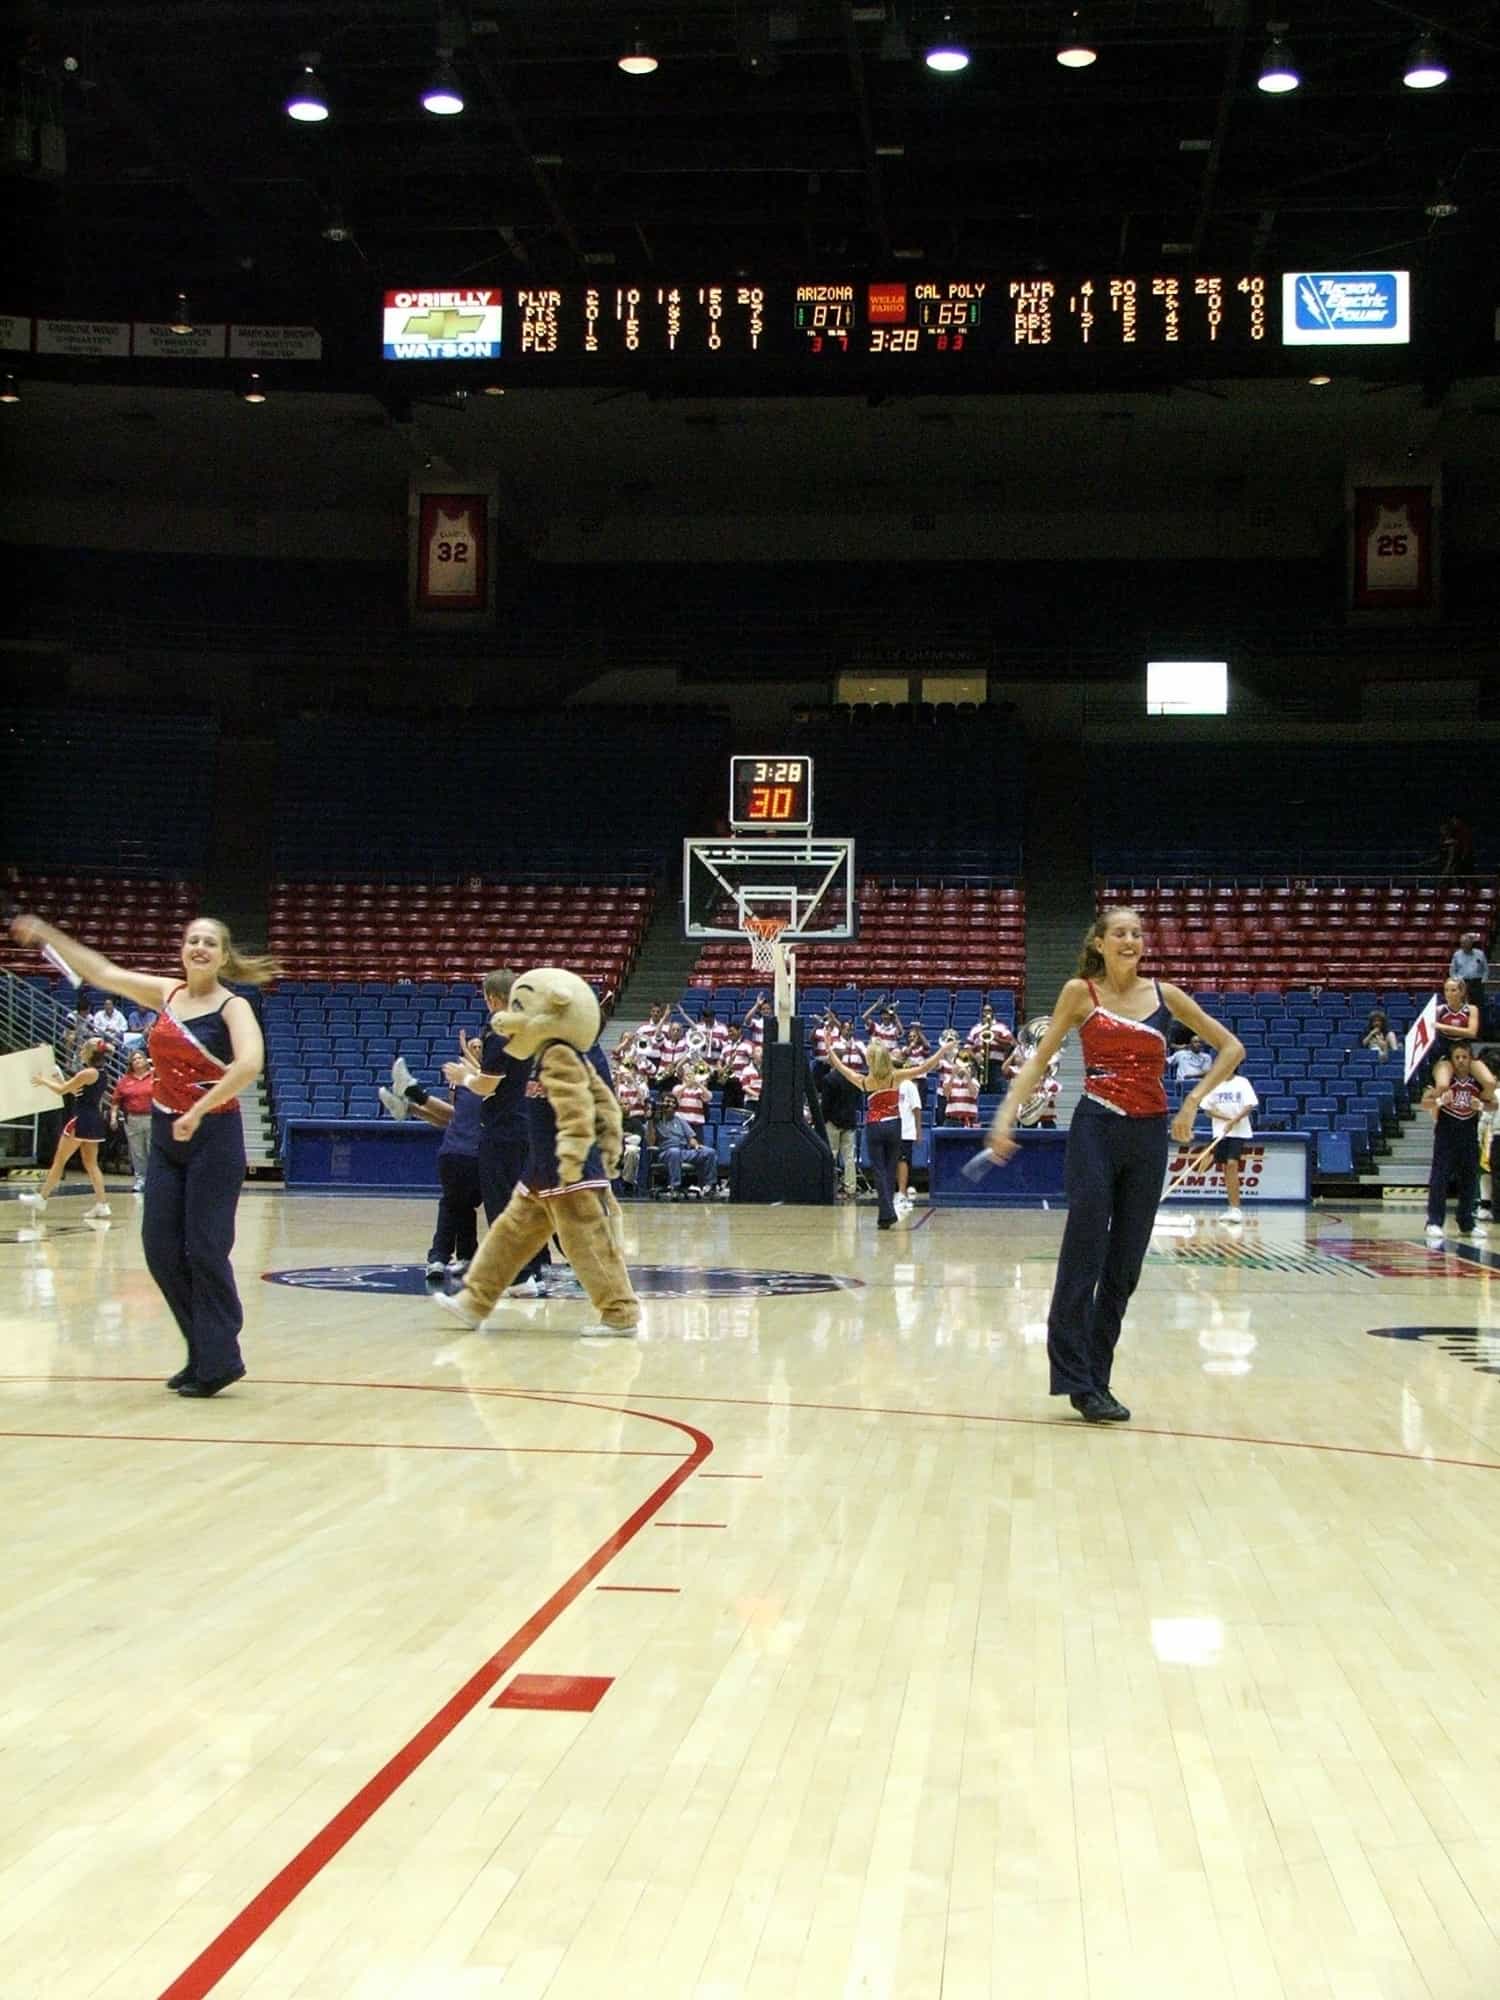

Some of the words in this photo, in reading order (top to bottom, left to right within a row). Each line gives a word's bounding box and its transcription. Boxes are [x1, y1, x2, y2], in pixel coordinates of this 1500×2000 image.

[518, 291, 560, 307] PLYR
[586, 290, 598, 305] 2
[617, 289, 640, 305] 10
[658, 289, 680, 305] 14
[699, 288, 722, 304] 15
[737, 288, 763, 304] 20
[797, 287, 853, 301] ARIZONA
[914, 285, 941, 299] CAL
[948, 284, 985, 299] POLY
[1009, 282, 1055, 299] PLYR
[1081, 281, 1094, 297] 4
[1110, 280, 1136, 296] 20
[1152, 280, 1178, 295] 22
[1194, 278, 1221, 294] 25
[1237, 278, 1264, 294] 40
[394, 292, 492, 307] O'RIELLY
[869, 296, 905, 304] WELLS
[1017, 298, 1049, 313] PTS
[1112, 295, 1136, 312] 12
[1208, 294, 1221, 309] 0
[1251, 294, 1264, 309] 0
[525, 306, 555, 321] PTS
[586, 306, 598, 320] 0
[709, 304, 722, 319] 0
[750, 304, 762, 319] 7
[812, 306, 842, 326] 87
[938, 303, 968, 324] 65
[1014, 313, 1051, 329] RBS
[1080, 312, 1094, 328] 3
[1123, 311, 1136, 326] 5
[1165, 311, 1178, 325] 4
[1208, 310, 1221, 324] 0
[1331, 309, 1389, 322] Power
[522, 321, 557, 336] RBS
[627, 320, 639, 335] 5
[750, 320, 762, 334] 3
[1014, 328, 1051, 344] FLS
[1123, 327, 1136, 342] 2
[1165, 326, 1178, 341] 2
[1251, 325, 1264, 340] 0
[522, 336, 557, 352] FLS
[585, 336, 598, 351] 2
[626, 335, 639, 350] 0
[708, 334, 721, 350] 0
[869, 330, 919, 352] 3:28
[393, 343, 491, 359] WATSON
[438, 542, 468, 562] 32
[1376, 534, 1408, 556] 25
[754, 763, 802, 782] 3:28
[750, 788, 792, 818] 30
